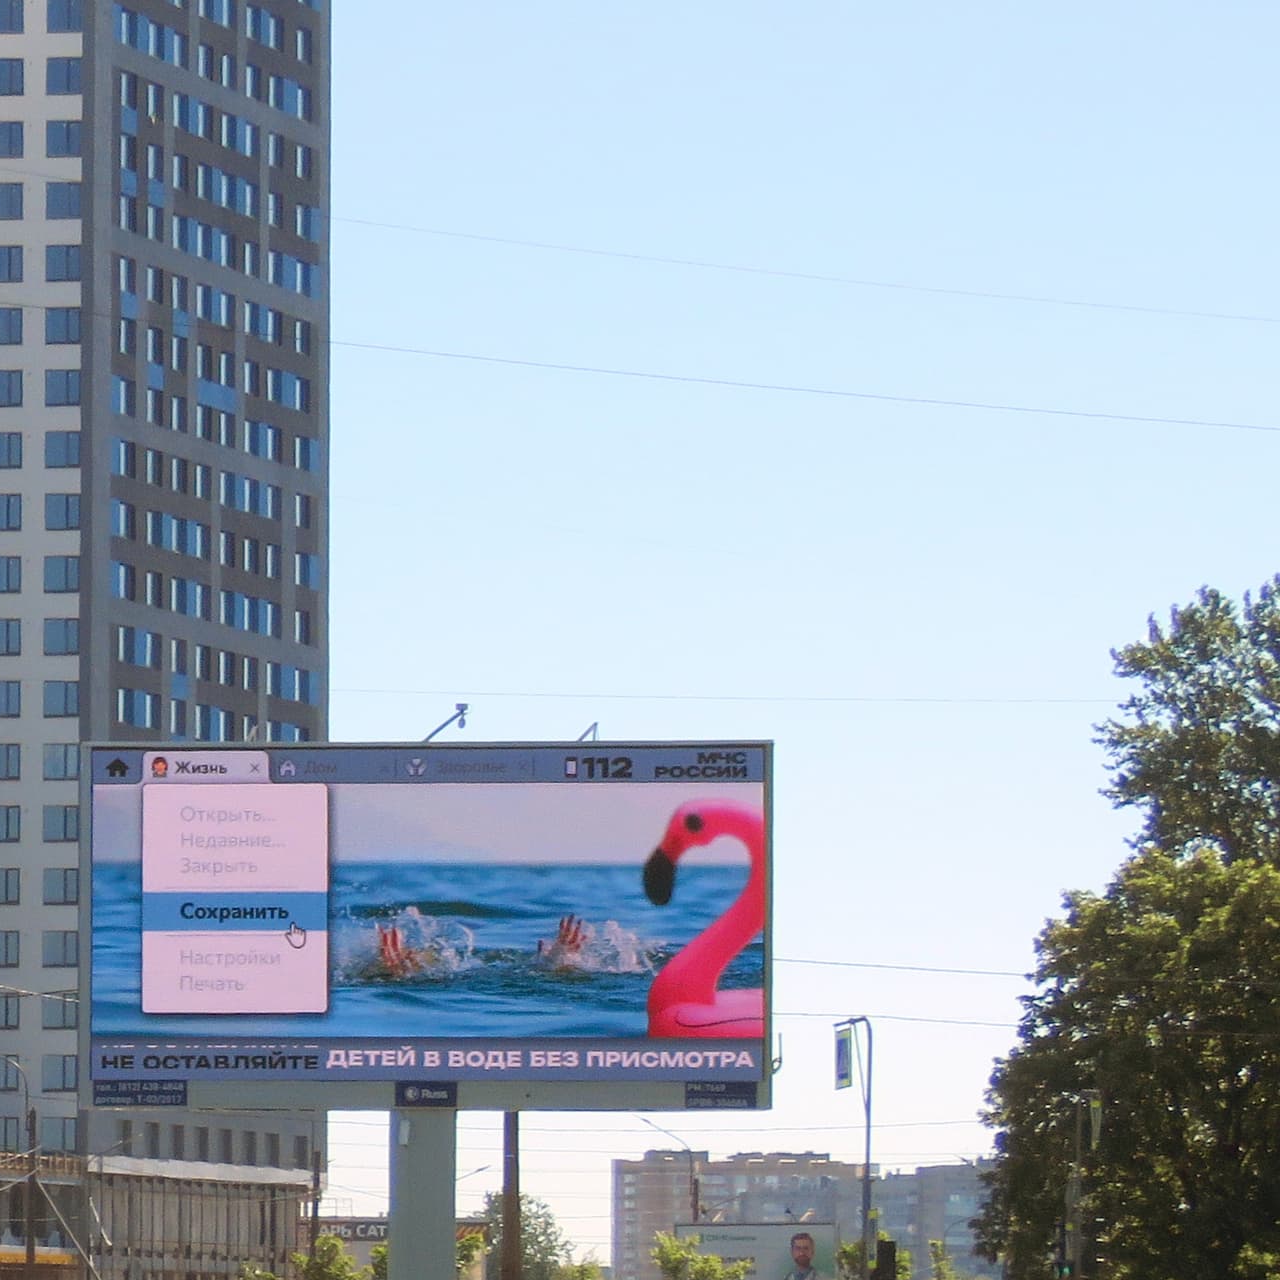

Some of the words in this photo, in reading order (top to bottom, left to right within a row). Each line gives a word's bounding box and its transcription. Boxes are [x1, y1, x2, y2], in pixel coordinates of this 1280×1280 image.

[697, 752, 748, 764] МЧС
[174, 760, 228, 775] Жизнь
[581, 757, 633, 778] 112
[654, 765, 748, 778] РОССИИ
[180, 806, 276, 824] Открыть...
[180, 832, 286, 850] Недавние...
[180, 857, 258, 876] Закрыть
[180, 902, 290, 923] Сохранить
[179, 949, 281, 968] Настройки
[179, 976, 245, 991] Печать
[101, 1055, 135, 1069] НЕ
[143, 1051, 318, 1069] ОСТАВЛЯЙТЕ
[326, 1046, 416, 1069] ДЕТЕЙ
[423, 1050, 440, 1068] В
[448, 1050, 522, 1070] ВОДЕ
[529, 1051, 579, 1068] БЕЗ
[586, 1051, 755, 1068] ПРИСМОТРА
[356, 1224, 388, 1238] САТ
